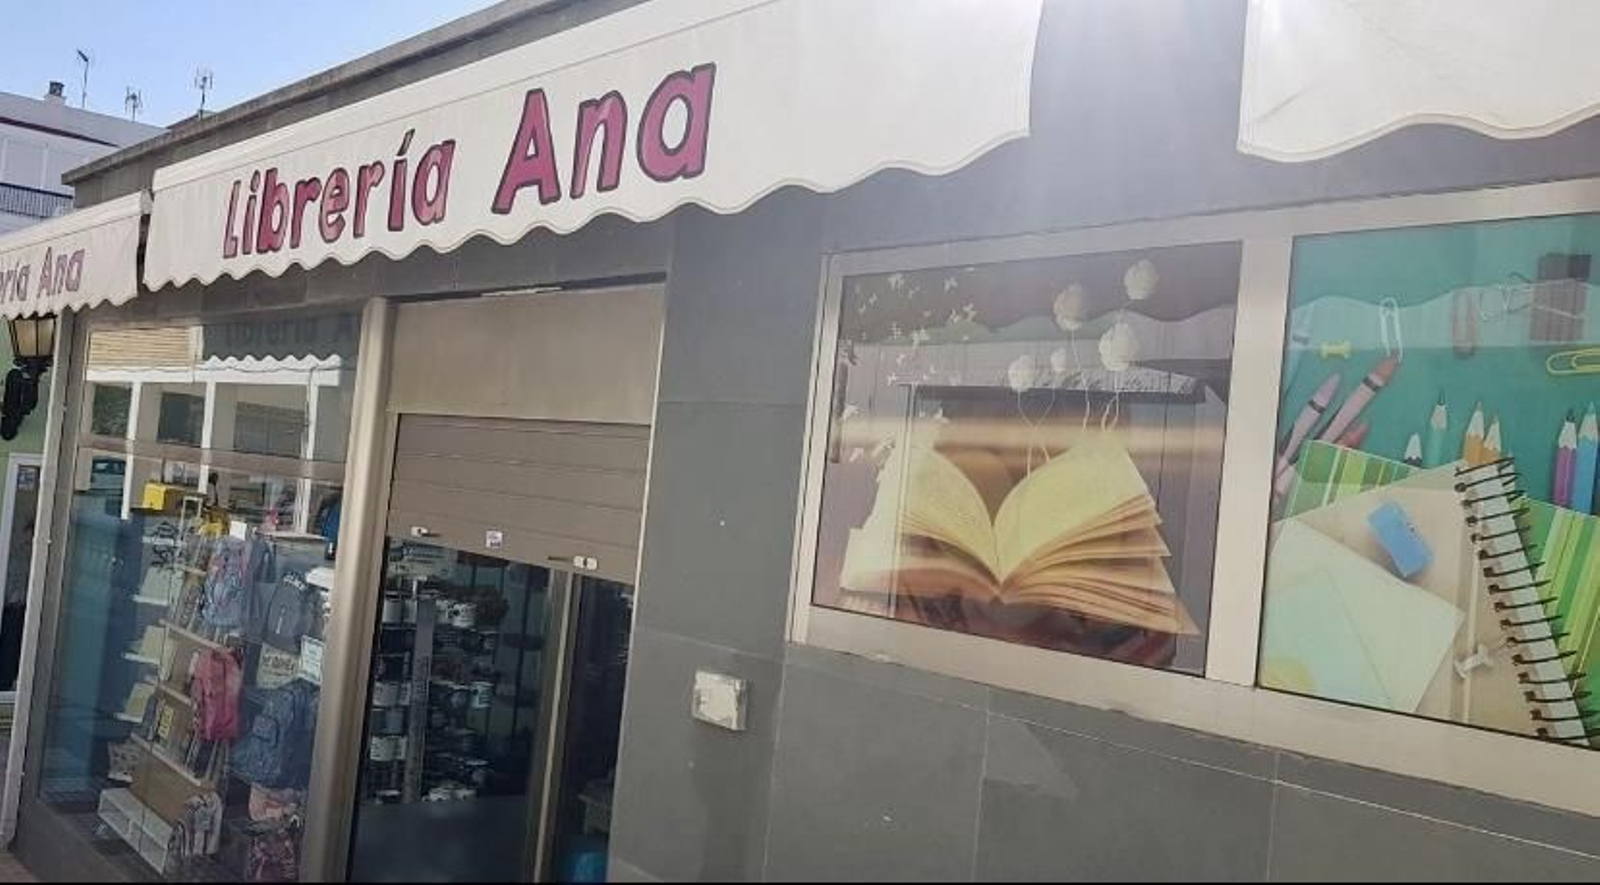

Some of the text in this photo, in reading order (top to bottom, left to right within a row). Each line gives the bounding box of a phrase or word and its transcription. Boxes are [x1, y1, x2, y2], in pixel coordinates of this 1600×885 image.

[222, 62, 717, 258] Librería Ana
[37, 246, 85, 298] Ana
